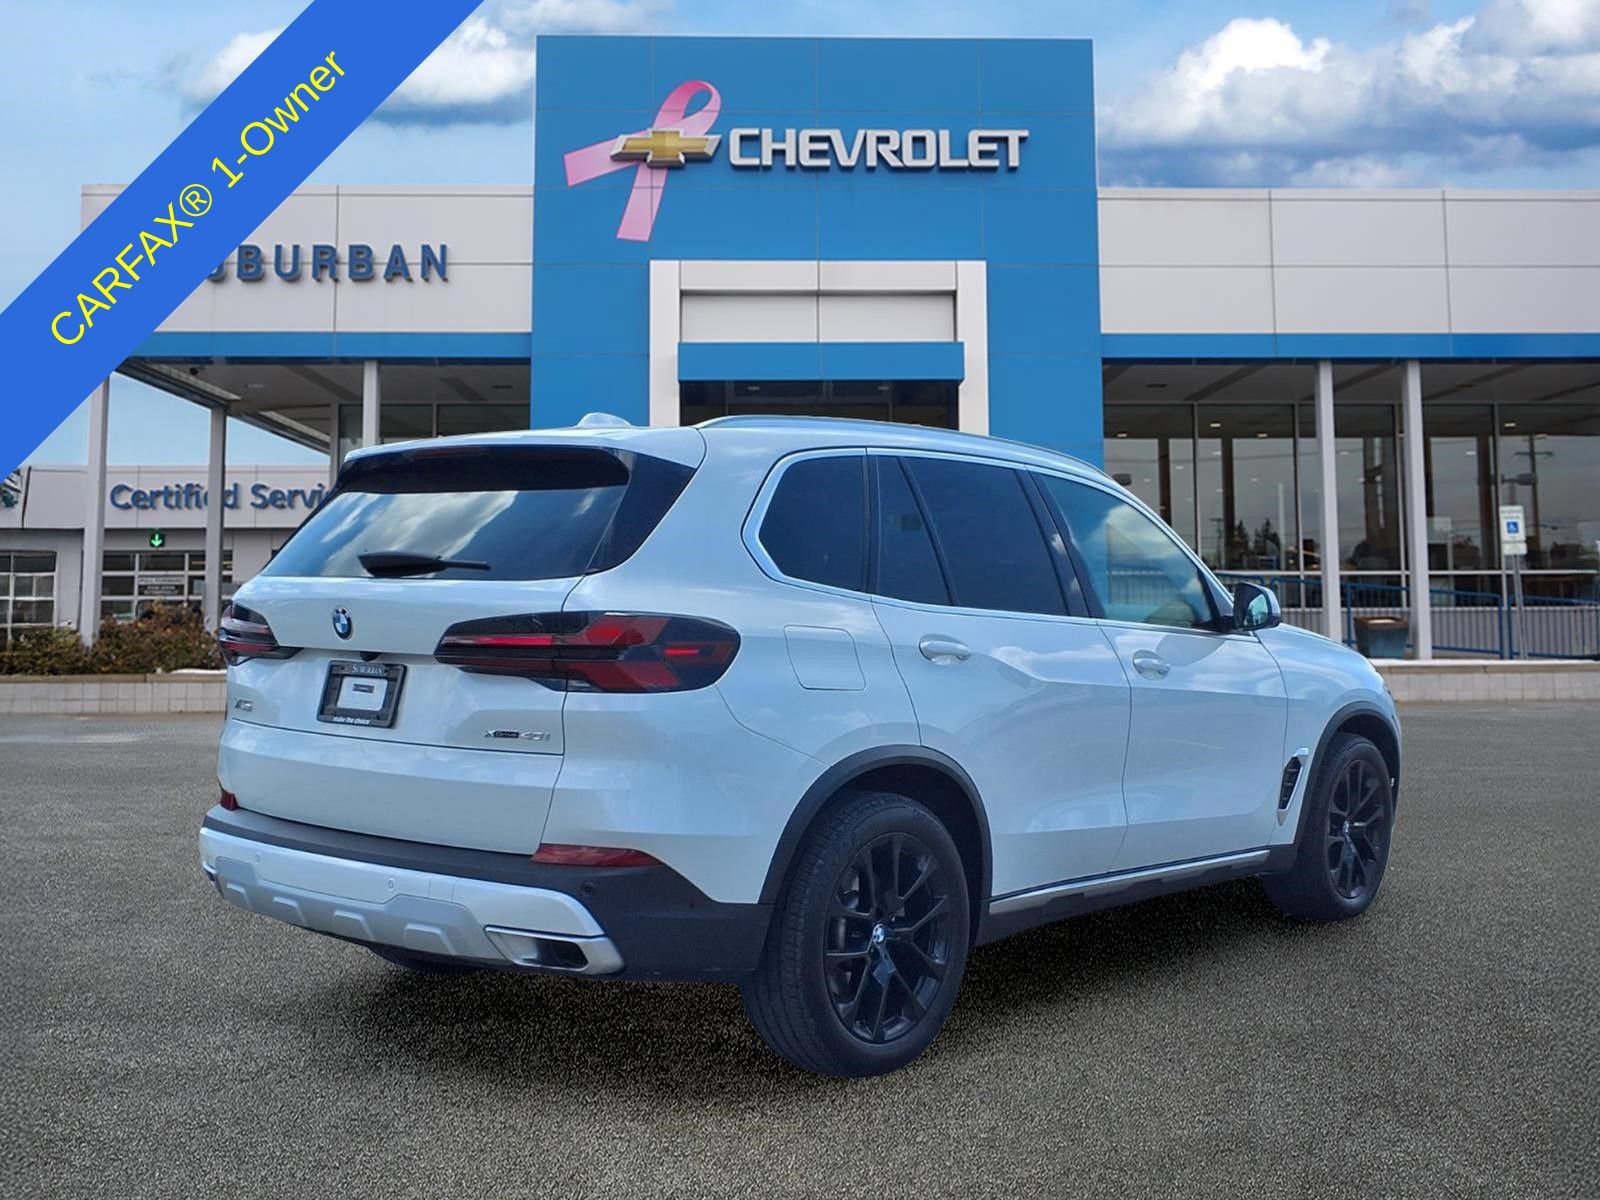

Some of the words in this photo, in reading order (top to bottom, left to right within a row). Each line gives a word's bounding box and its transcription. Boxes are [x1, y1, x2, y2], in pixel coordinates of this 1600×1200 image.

[729, 128, 1030, 169] CHEVROLET
[207, 244, 449, 283] BURBAN
[110, 482, 240, 511] Certifid
[250, 483, 331, 510] Servi
